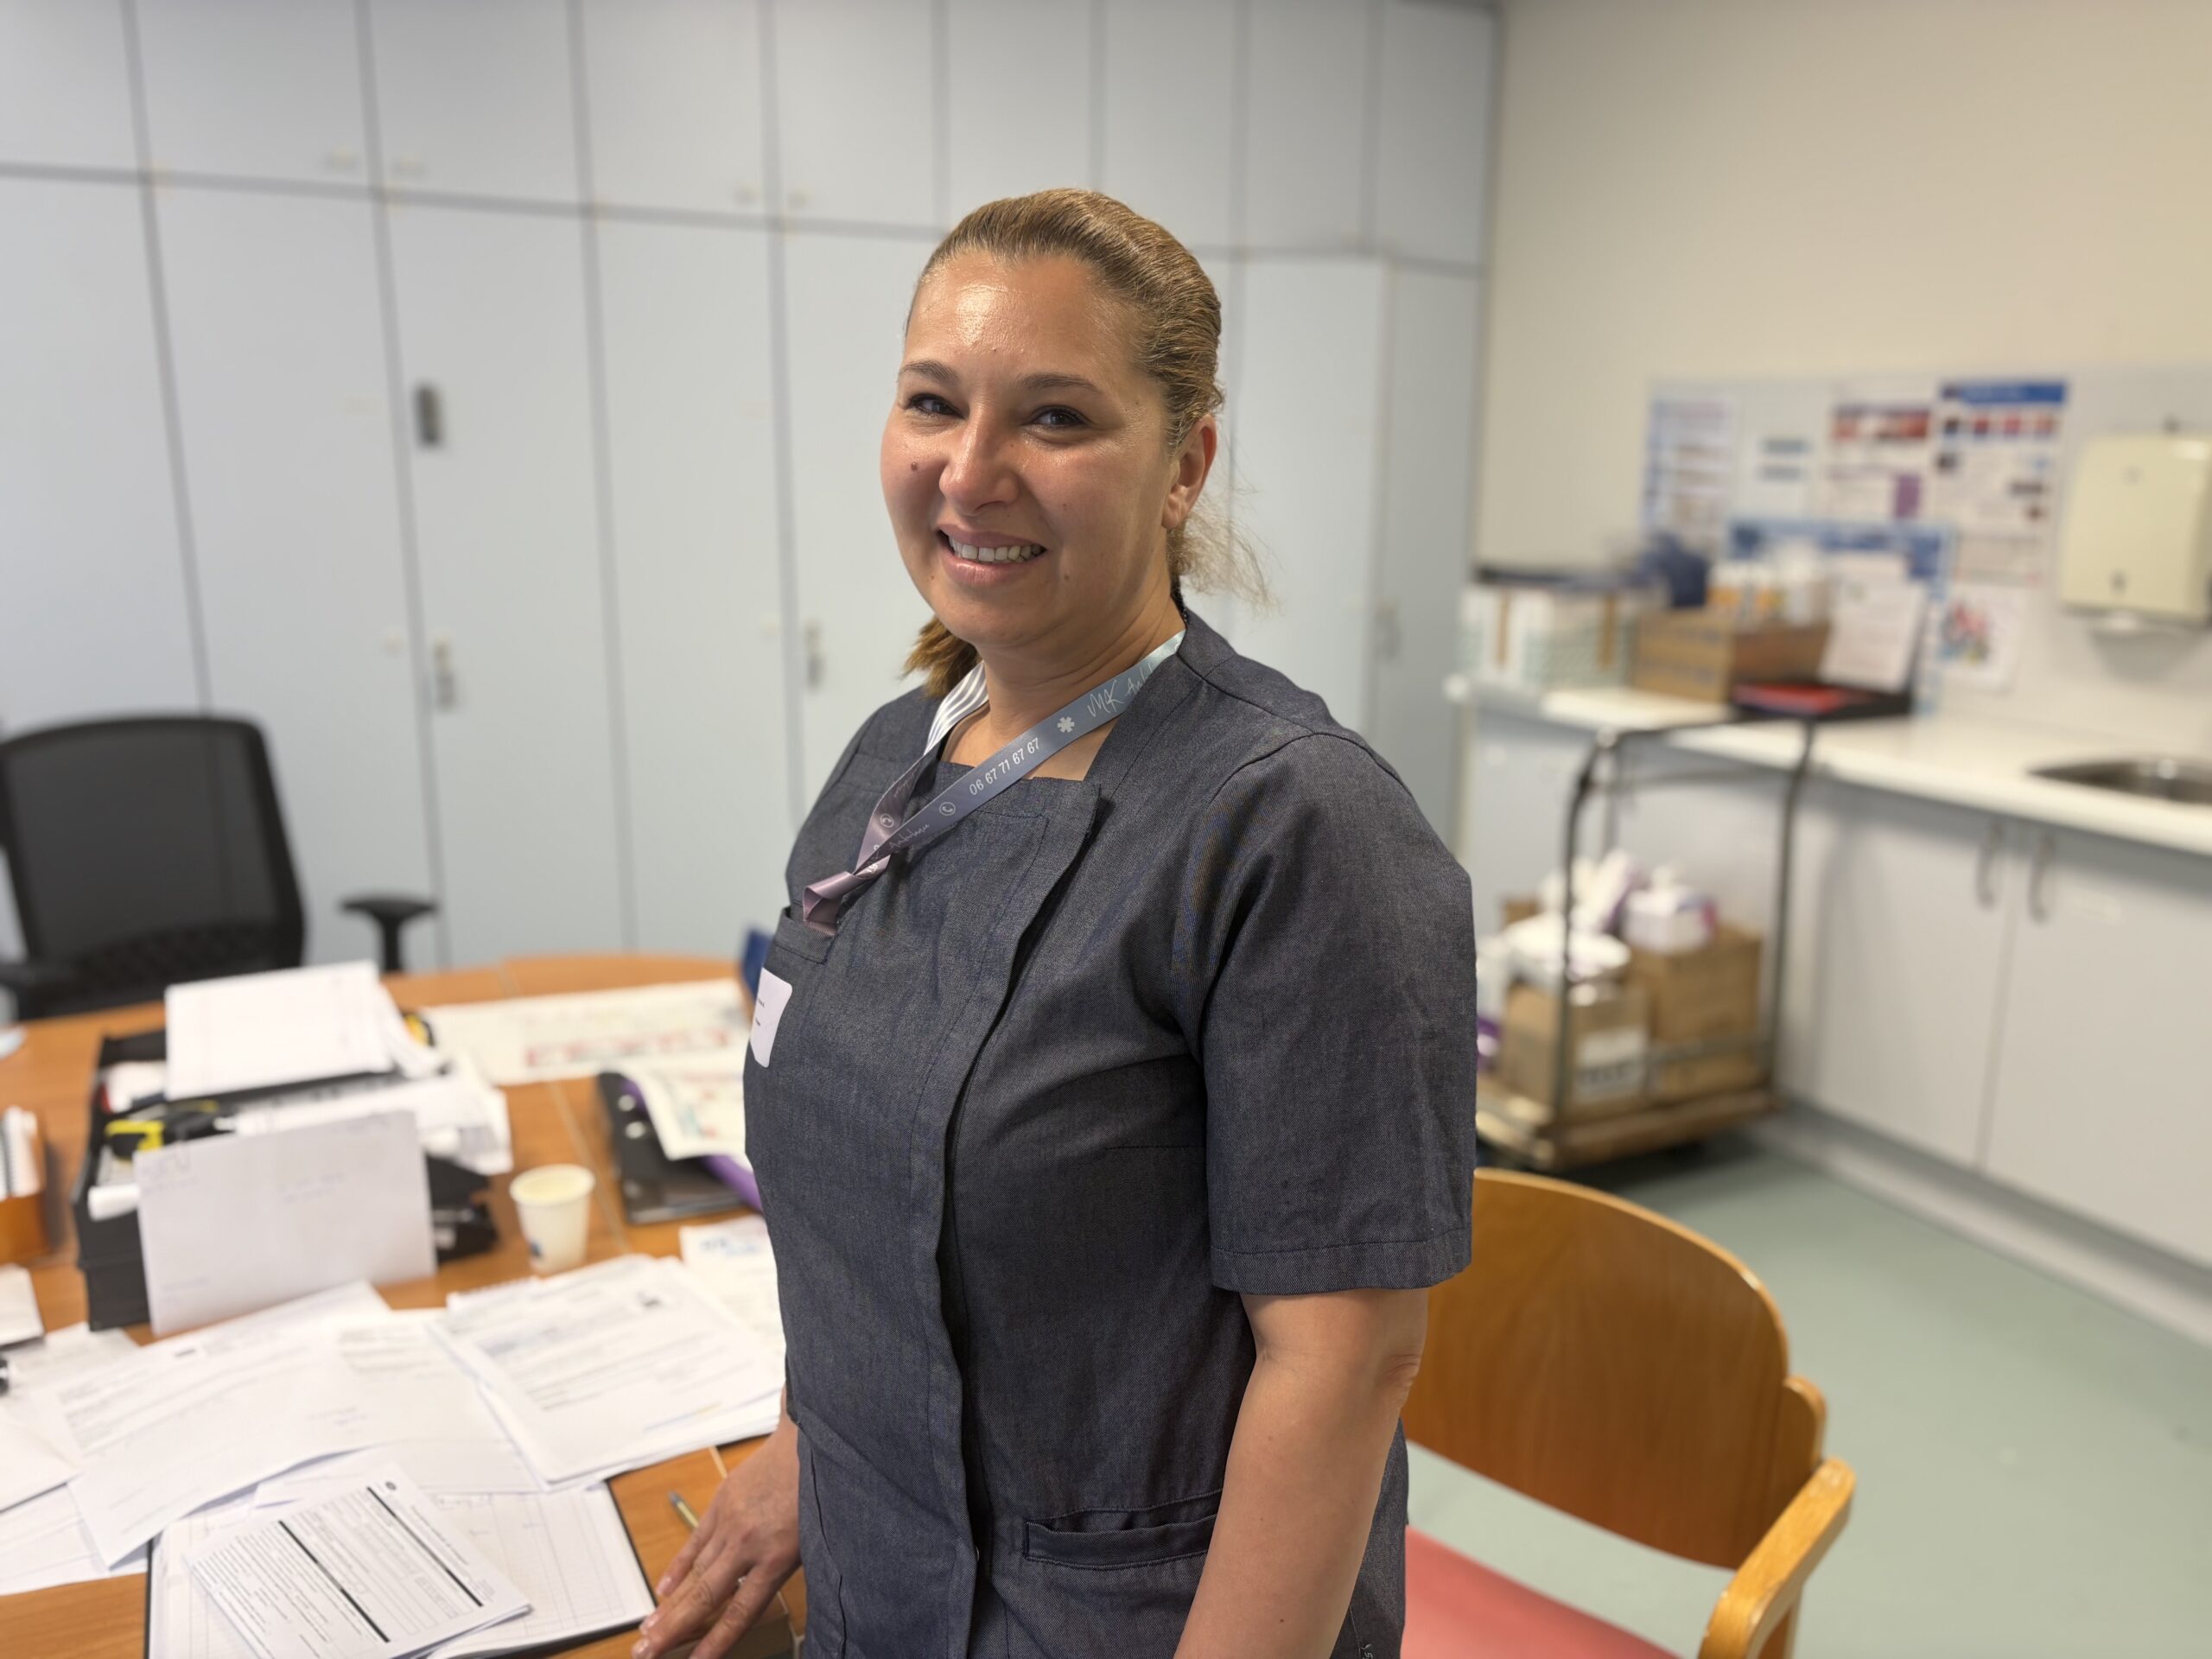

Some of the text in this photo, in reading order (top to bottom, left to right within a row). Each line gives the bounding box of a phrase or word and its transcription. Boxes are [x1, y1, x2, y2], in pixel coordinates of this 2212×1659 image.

[969, 737, 1039, 796] 06 67 71 67 67
